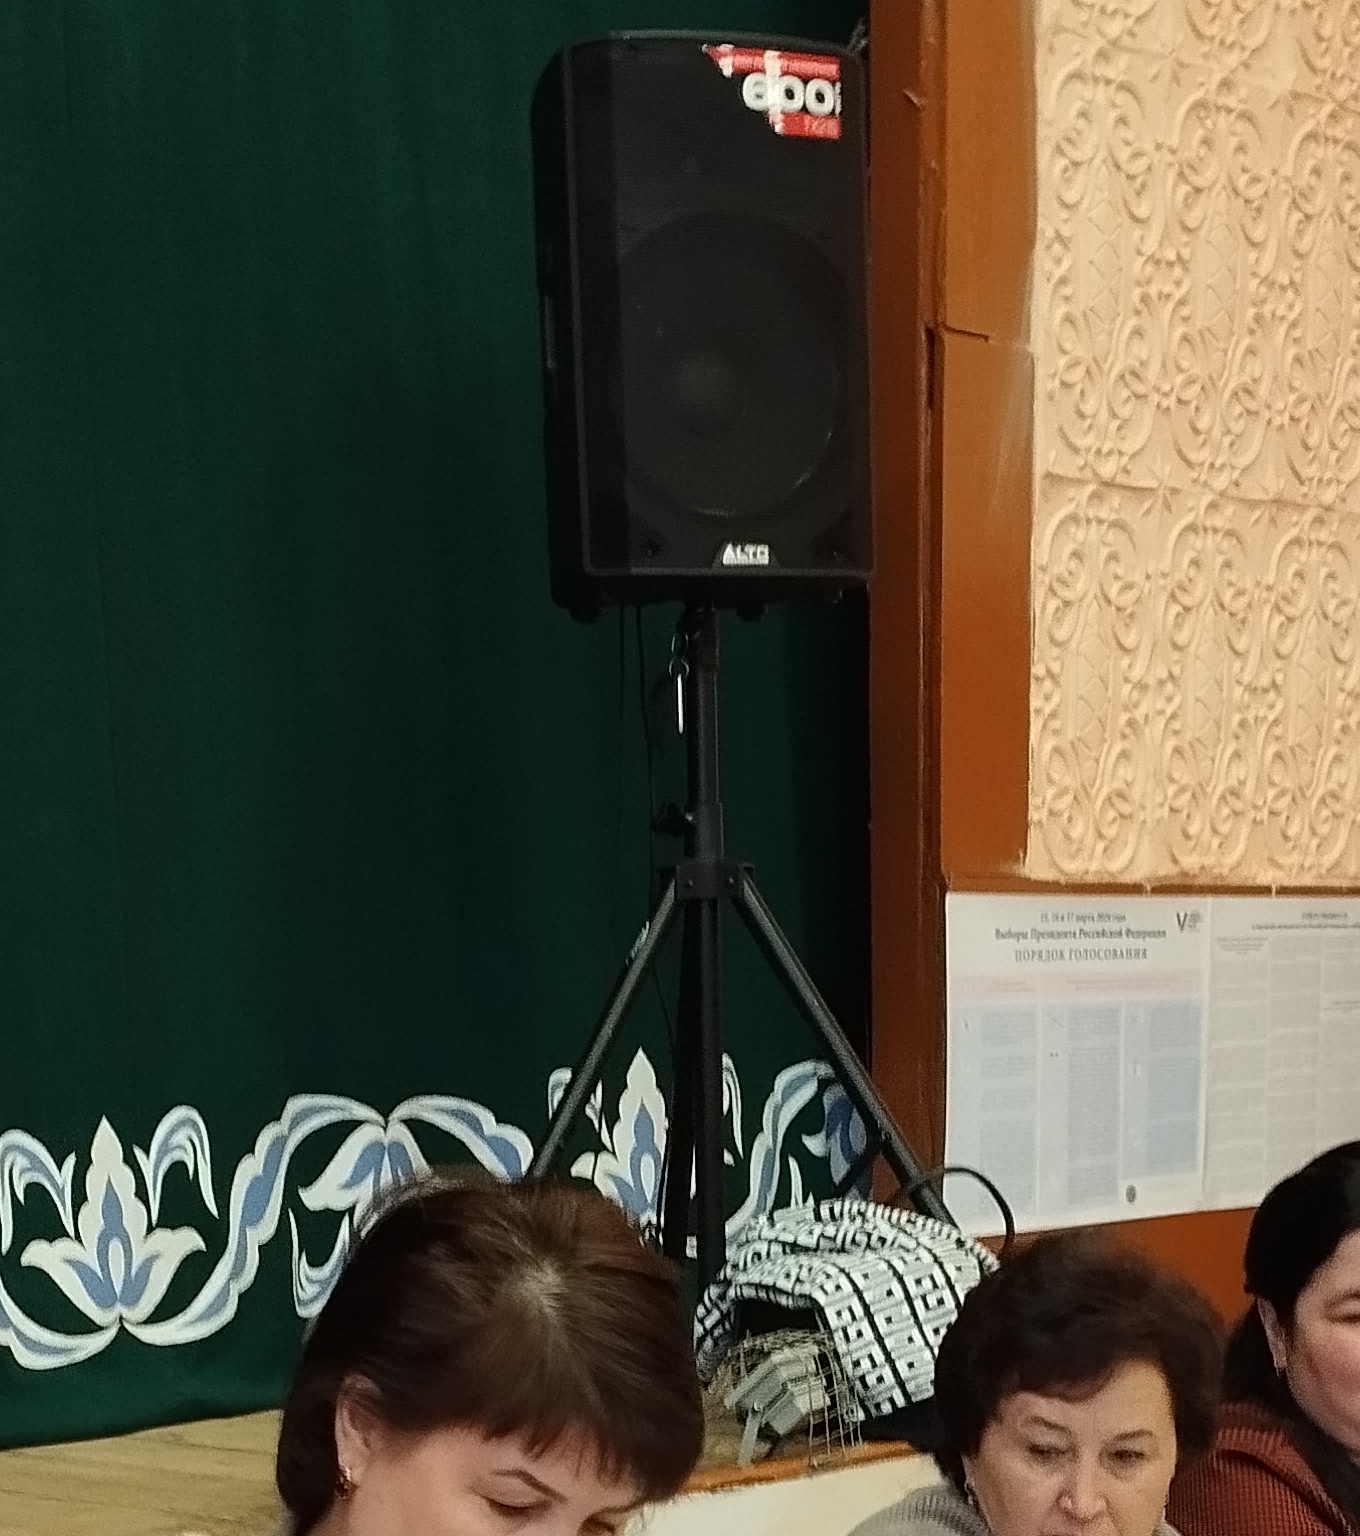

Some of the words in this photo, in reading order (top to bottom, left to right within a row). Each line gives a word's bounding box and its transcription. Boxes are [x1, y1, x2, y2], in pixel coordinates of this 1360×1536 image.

[722, 543, 770, 562] ALTO
[1014, 949, 1066, 963] ПОРЯДОК
[1068, 947, 1148, 962] ГОЛОСОВАНИЯ
